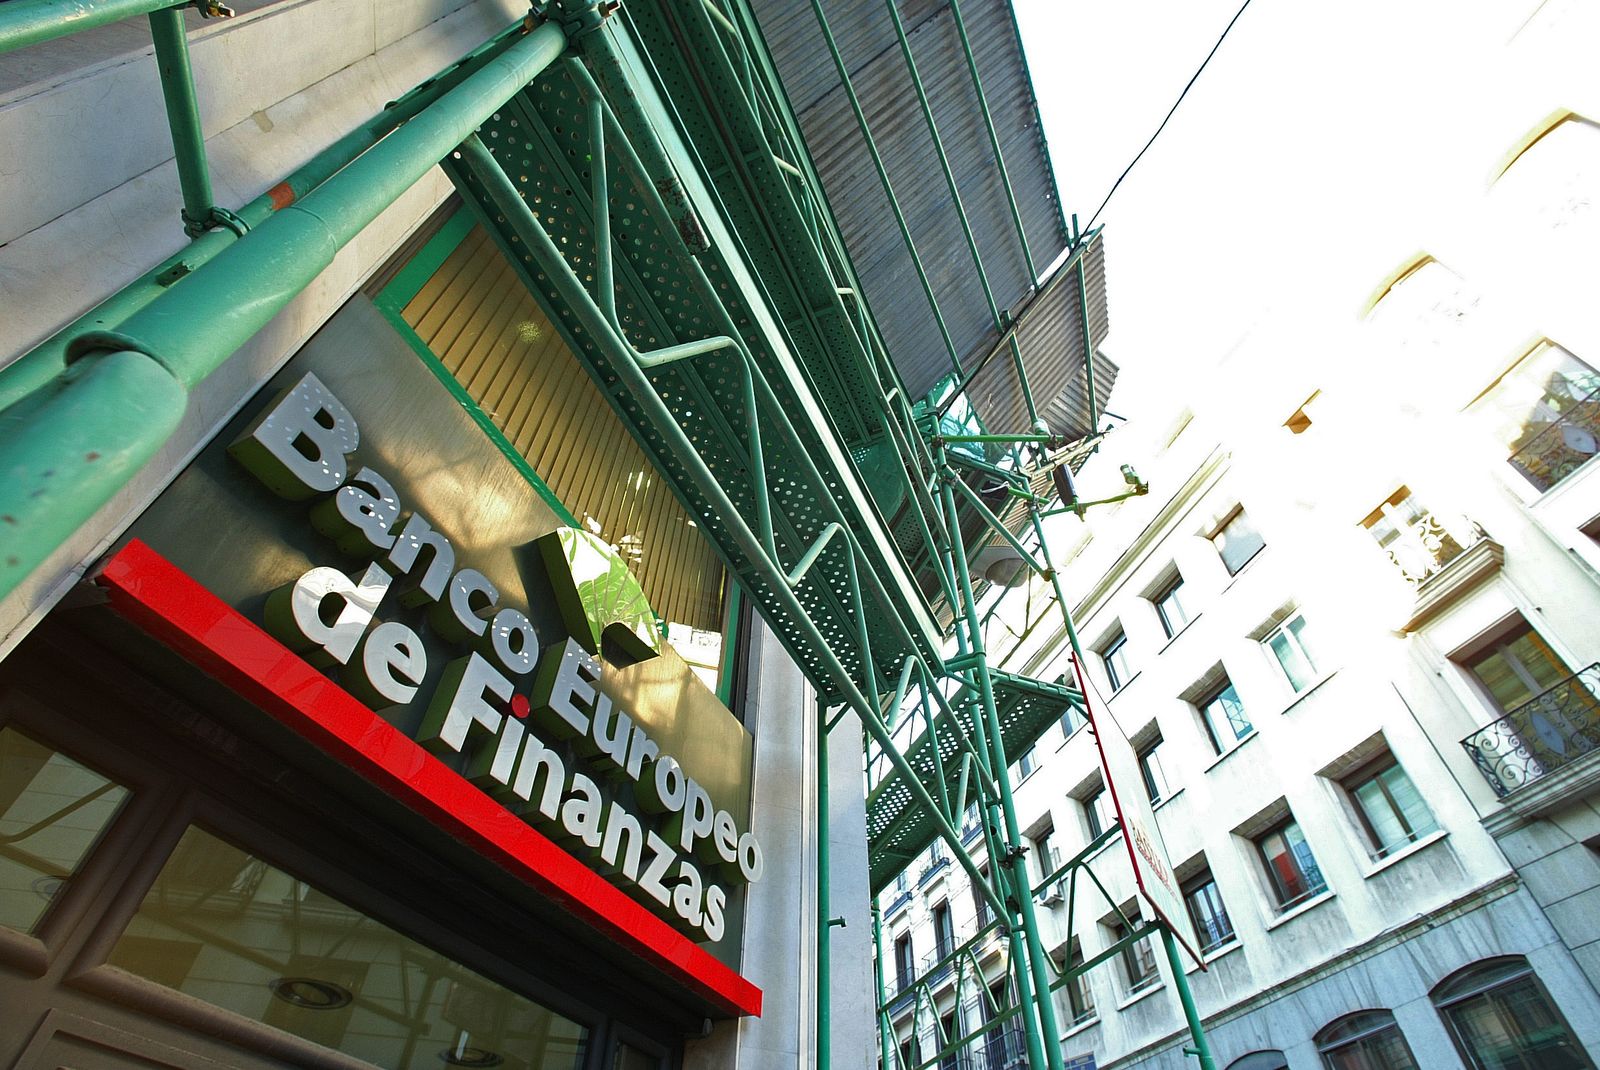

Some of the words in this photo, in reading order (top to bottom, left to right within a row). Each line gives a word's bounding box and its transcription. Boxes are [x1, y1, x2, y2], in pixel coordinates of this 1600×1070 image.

[252, 370, 540, 675] Banco
[547, 636, 764, 883] Europeo
[291, 561, 428, 704] de
[438, 651, 726, 943] Finanzas
